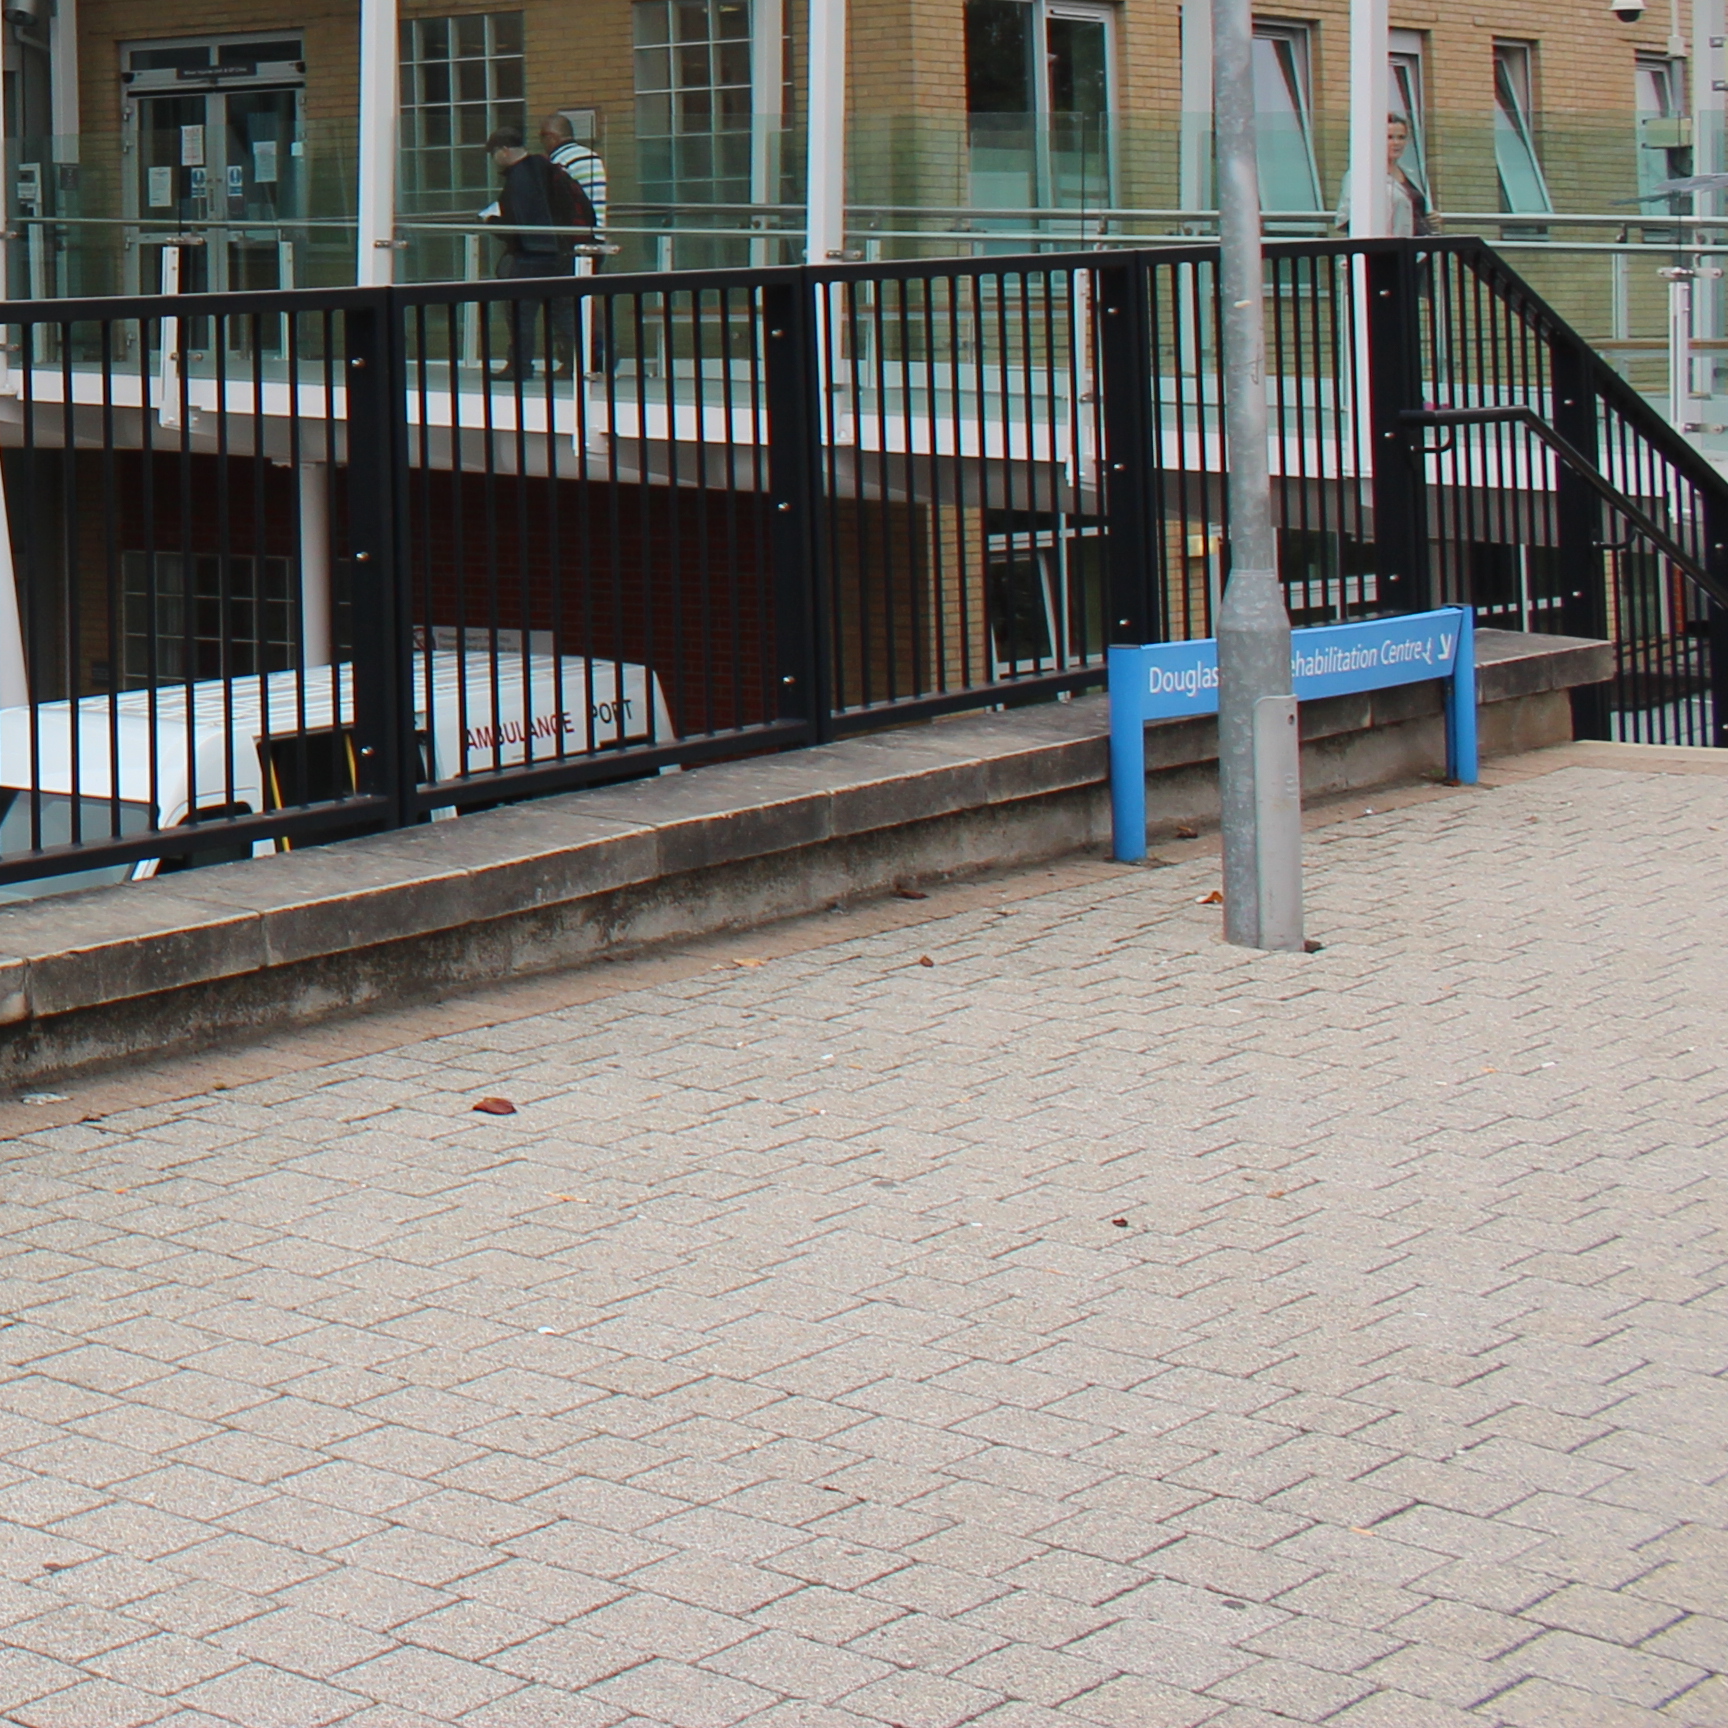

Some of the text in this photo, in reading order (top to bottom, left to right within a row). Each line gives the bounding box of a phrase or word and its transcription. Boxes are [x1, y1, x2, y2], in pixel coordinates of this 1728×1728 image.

[1148, 638, 1423, 698] Douglas habilitation Centre
